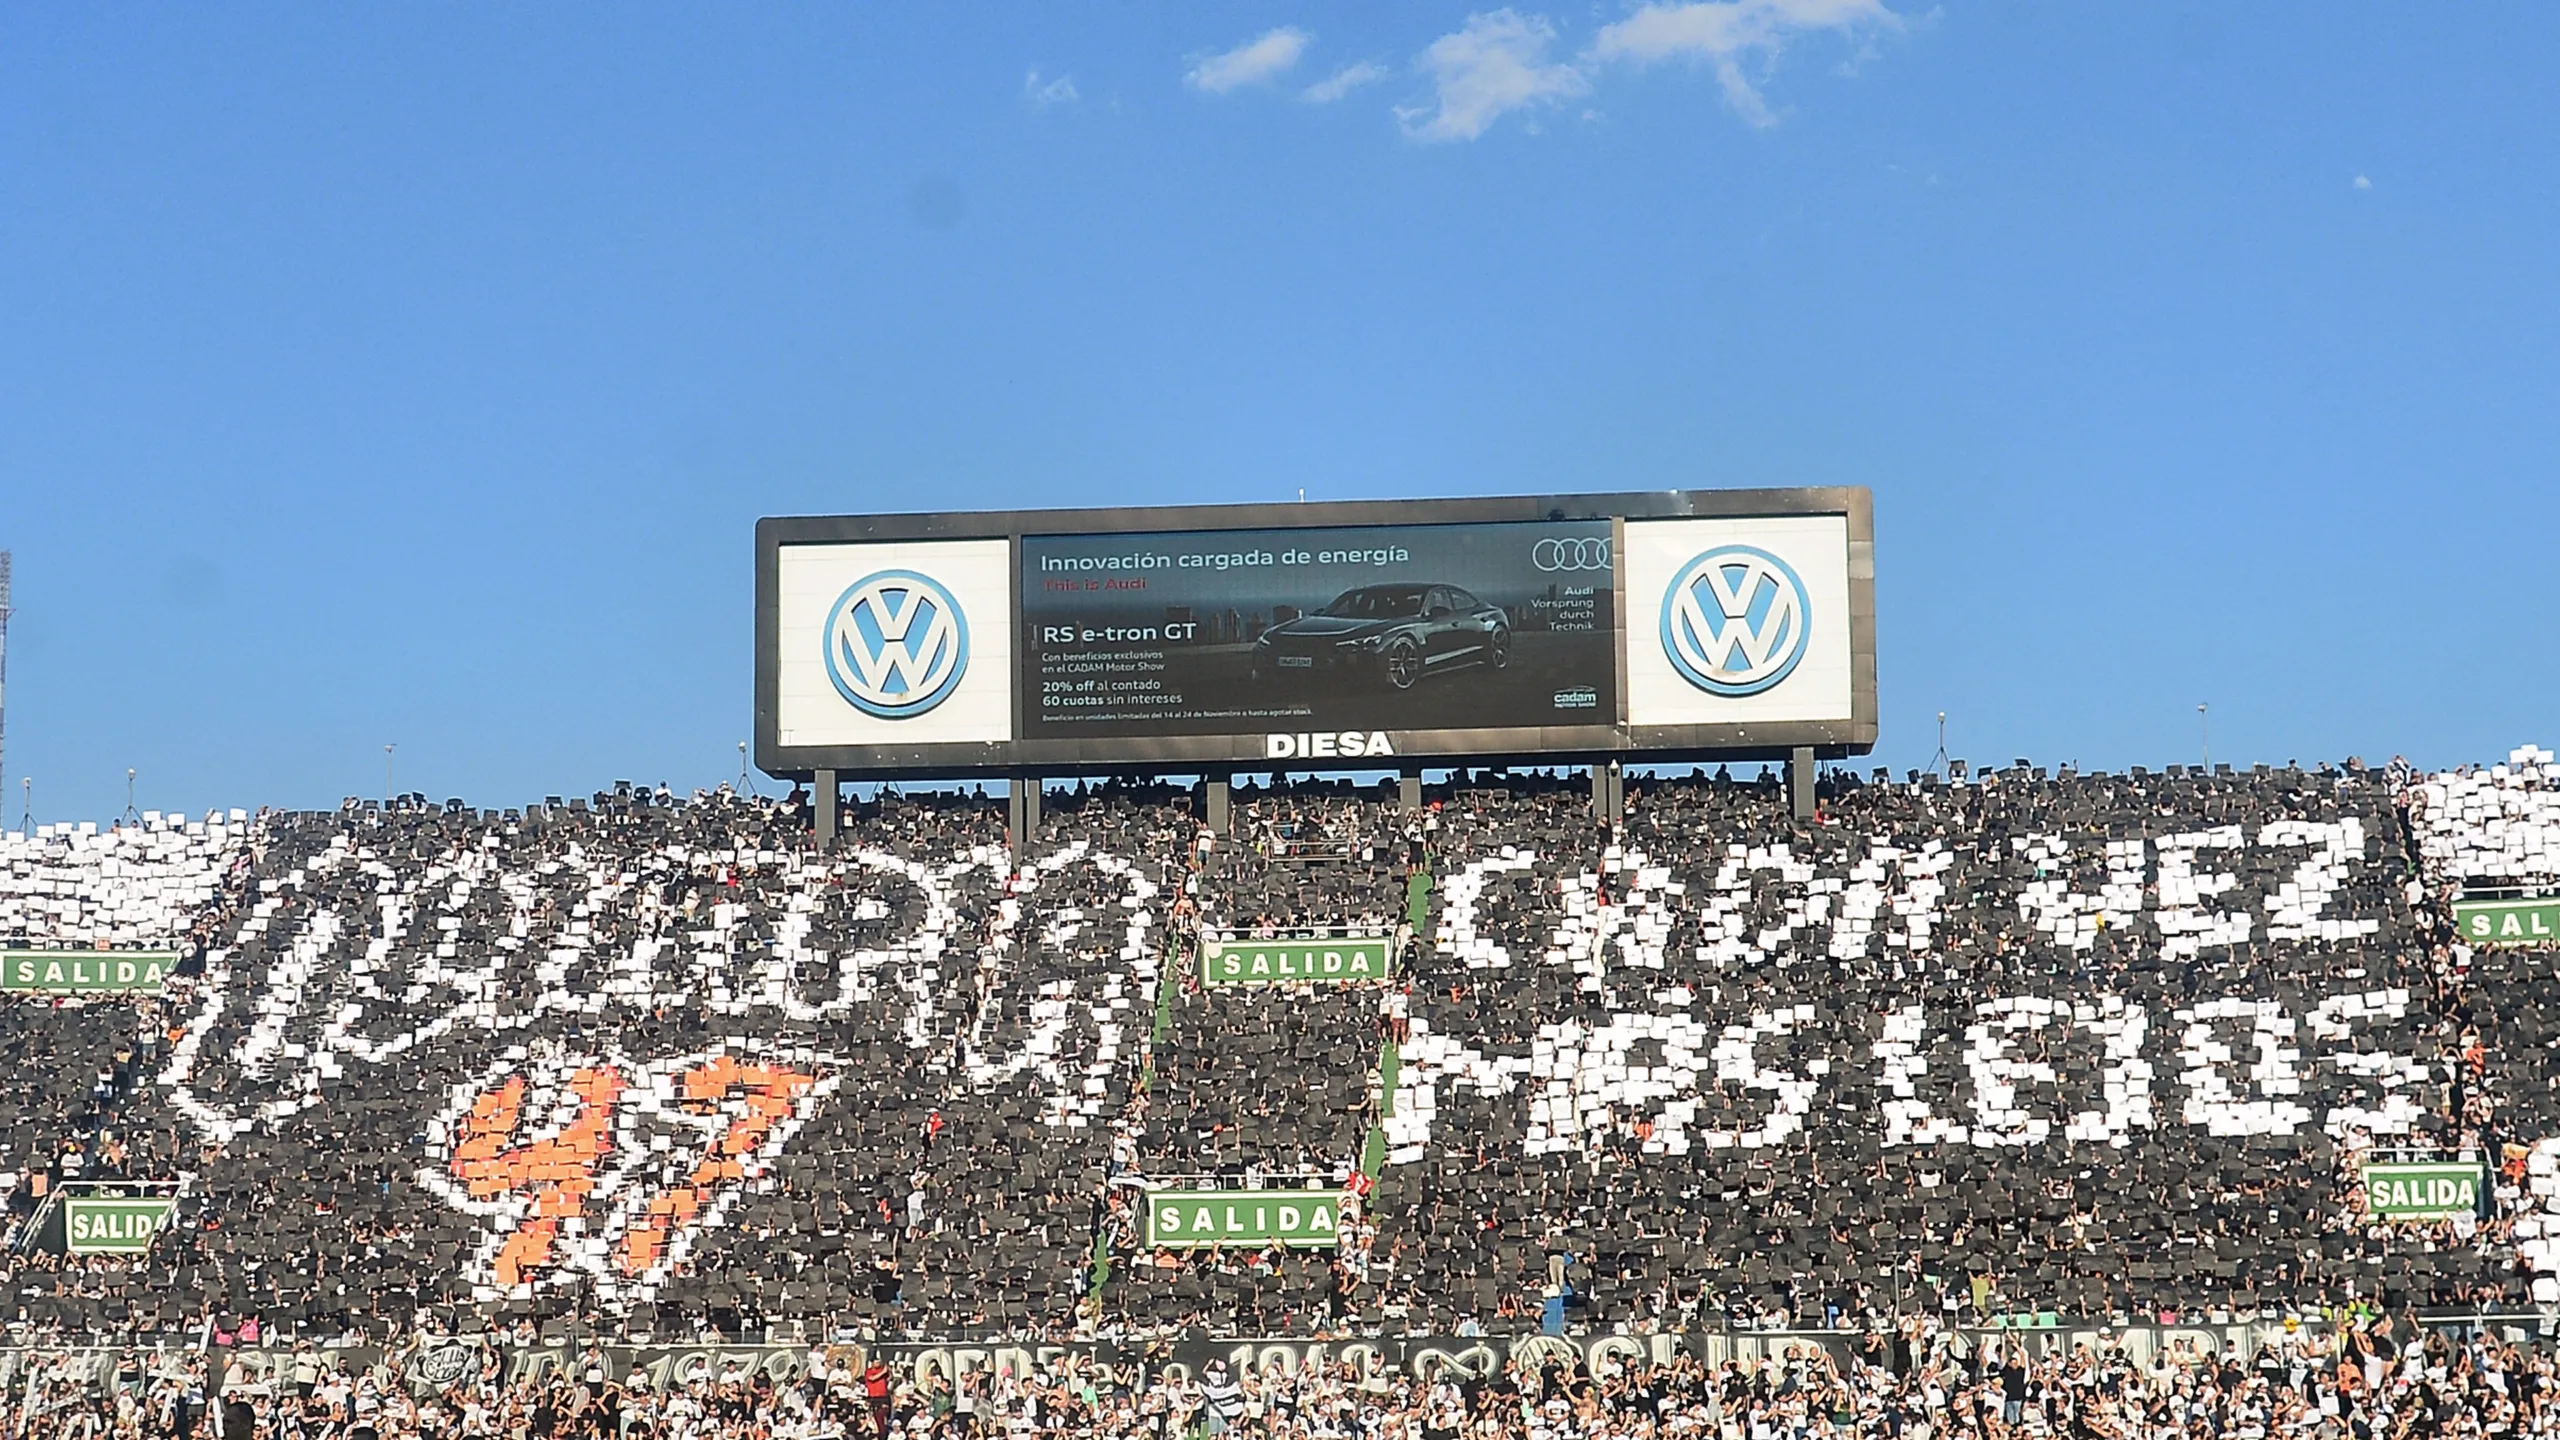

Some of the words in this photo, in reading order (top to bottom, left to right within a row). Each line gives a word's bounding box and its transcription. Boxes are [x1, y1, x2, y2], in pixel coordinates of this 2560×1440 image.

[1041, 552, 1171, 571] Innovación
[1178, 549, 1275, 570] cargada
[1281, 548, 1311, 565] de
[1318, 544, 1409, 567] energía
[1044, 578, 1079, 592] This
[1084, 577, 1099, 590] is
[1105, 576, 1147, 590] Audi
[1564, 586, 1594, 596] Audi
[1530, 599, 1594, 609] Vorsprung
[1559, 610, 1594, 619] durch
[1043, 626, 1075, 643] RS
[1081, 625, 1157, 642] e-tron
[1164, 622, 1197, 641] GT
[1550, 621, 1595, 630] Technik
[1041, 652, 1061, 662] Con
[1062, 650, 1112, 661] beneficios
[1113, 649, 1164, 660] exclusivos
[1041, 666, 1055, 674] en
[1056, 664, 1066, 673] el
[1067, 663, 1104, 673] CADAM
[1105, 662, 1136, 672] Motor
[1137, 661, 1165, 672] Show
[1042, 681, 1074, 693] 20%
[1075, 679, 1095, 692] off
[1096, 679, 1109, 691] al
[1111, 679, 1161, 690] contado
[1042, 695, 1061, 707] 60
[1062, 695, 1104, 707] cuotas
[1106, 693, 1125, 705] sin
[1127, 693, 1183, 705] intereses
[1554, 692, 1596, 703] cadam
[1265, 731, 1395, 759] DIESA
[2471, 912, 2560, 937] SAL
[1223, 952, 1371, 975] SALIDA
[17, 961, 163, 984] SALIDA
[440, 1045, 830, 1295] 47
[2372, 1179, 2476, 1208] SALIDA
[1159, 1206, 1334, 1233] SALIDA
